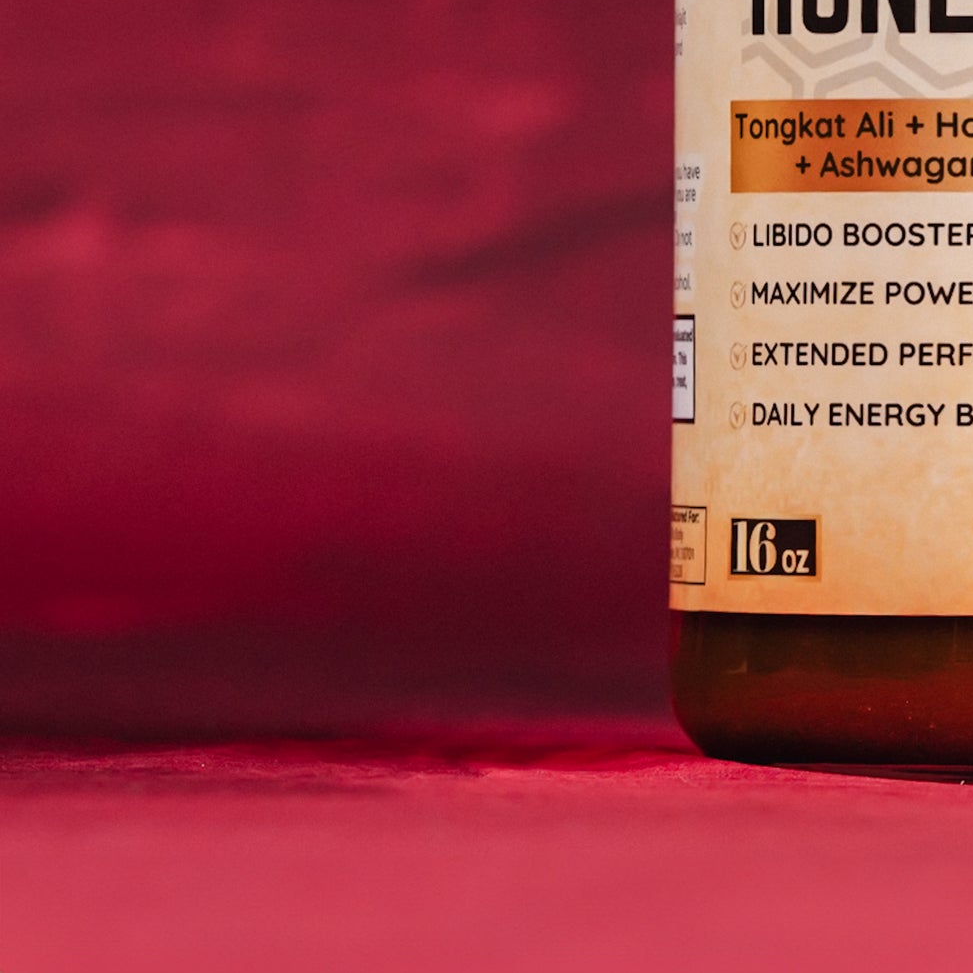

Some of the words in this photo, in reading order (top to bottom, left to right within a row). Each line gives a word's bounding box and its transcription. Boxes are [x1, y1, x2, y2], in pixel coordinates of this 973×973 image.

[735, 112, 844, 145] Tongkat
[856, 111, 894, 139] Ali
[905, 118, 925, 135] +
[795, 157, 811, 175] +
[753, 223, 832, 246] LIBIDO
[751, 282, 874, 305] MAXIMIZE
[752, 343, 887, 366] EXTENDED
[752, 403, 819, 426] DAILY
[830, 403, 945, 426] ENERGY
[733, 521, 777, 573] 16
